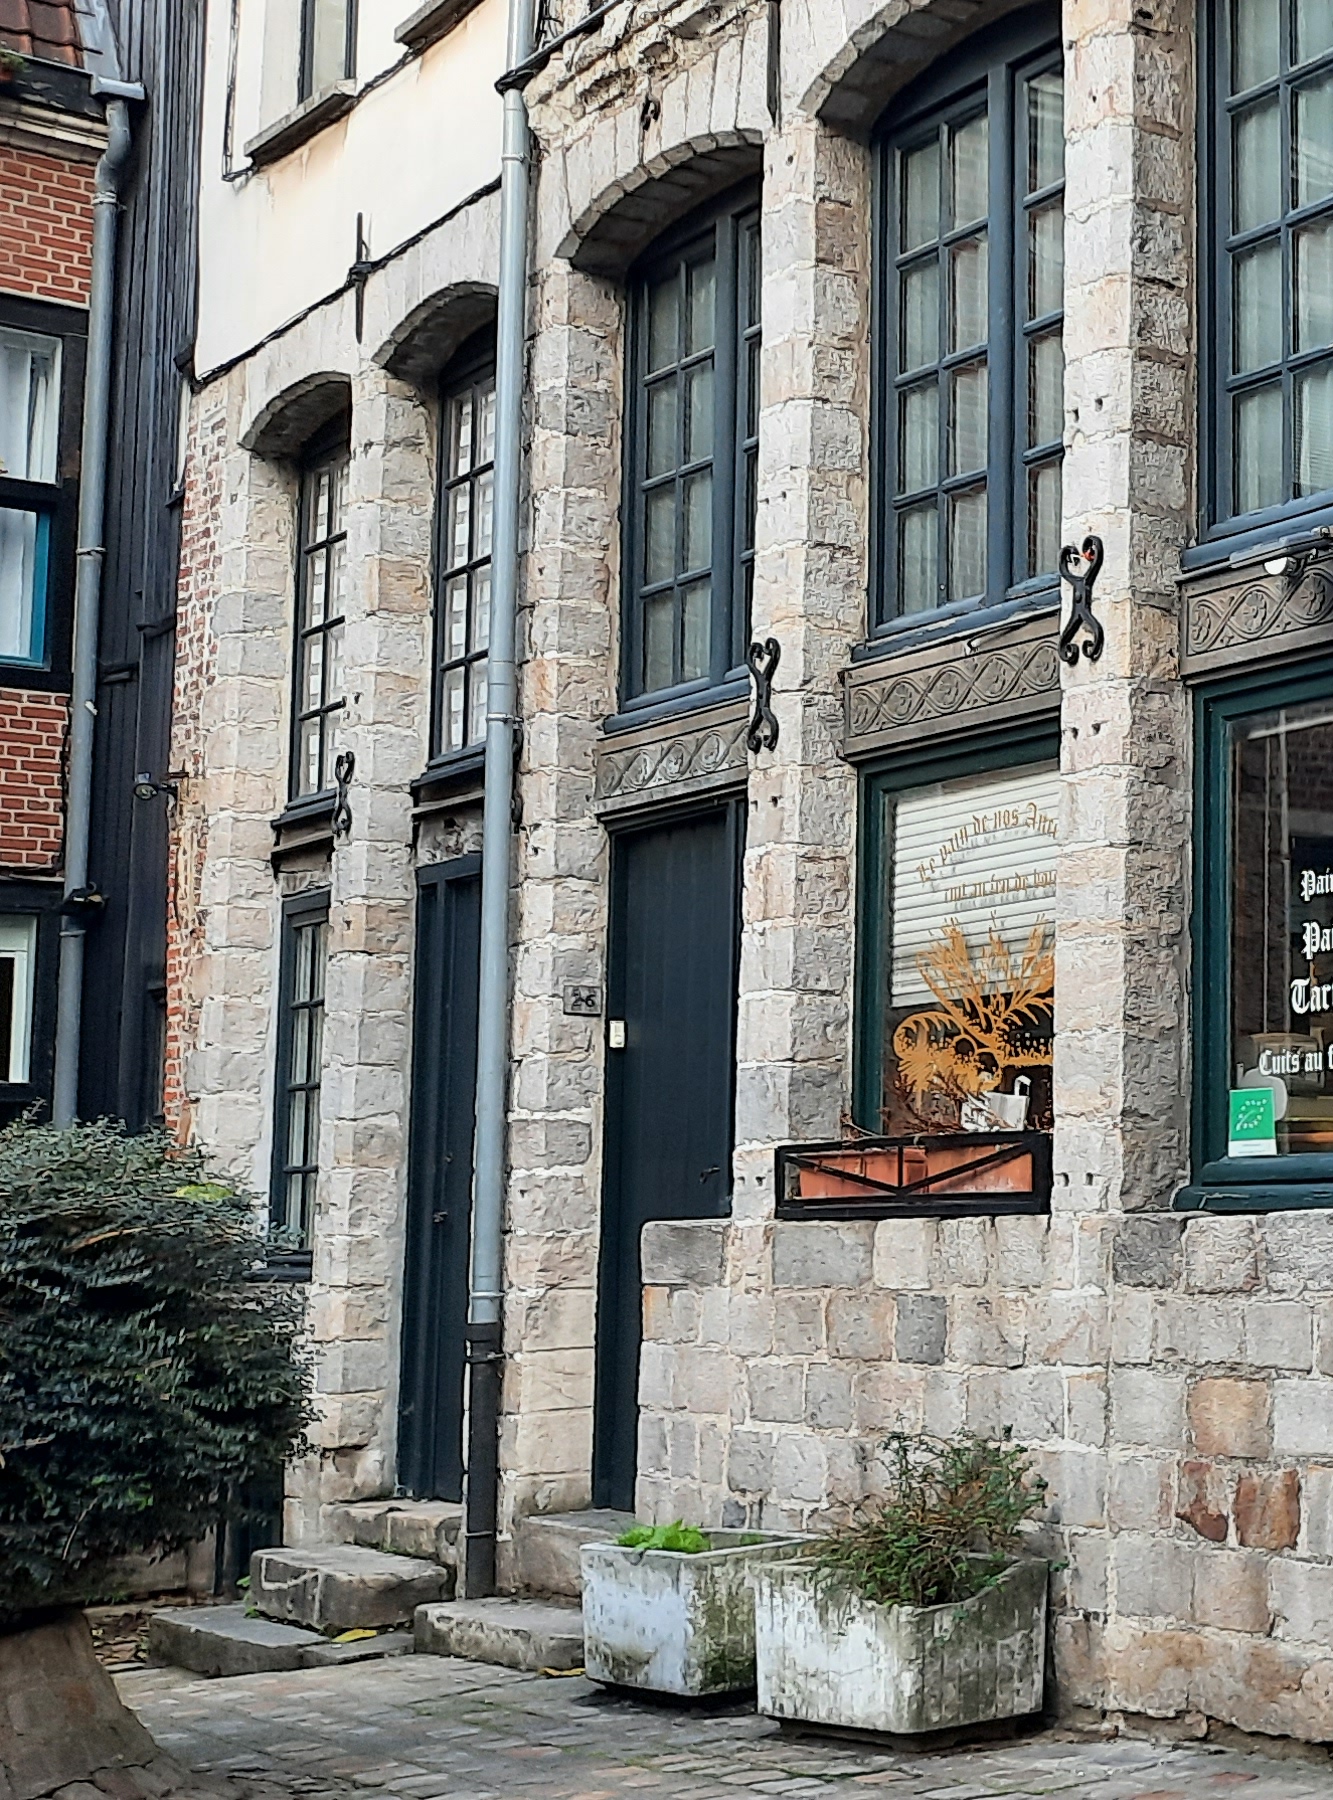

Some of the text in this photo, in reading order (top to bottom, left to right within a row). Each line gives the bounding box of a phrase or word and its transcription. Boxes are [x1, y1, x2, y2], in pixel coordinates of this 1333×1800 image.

[972, 814, 988, 836] de
[994, 806, 1020, 829] nos
[1259, 1049, 1301, 1076] Cuits
[1304, 1050, 1323, 1072] au
